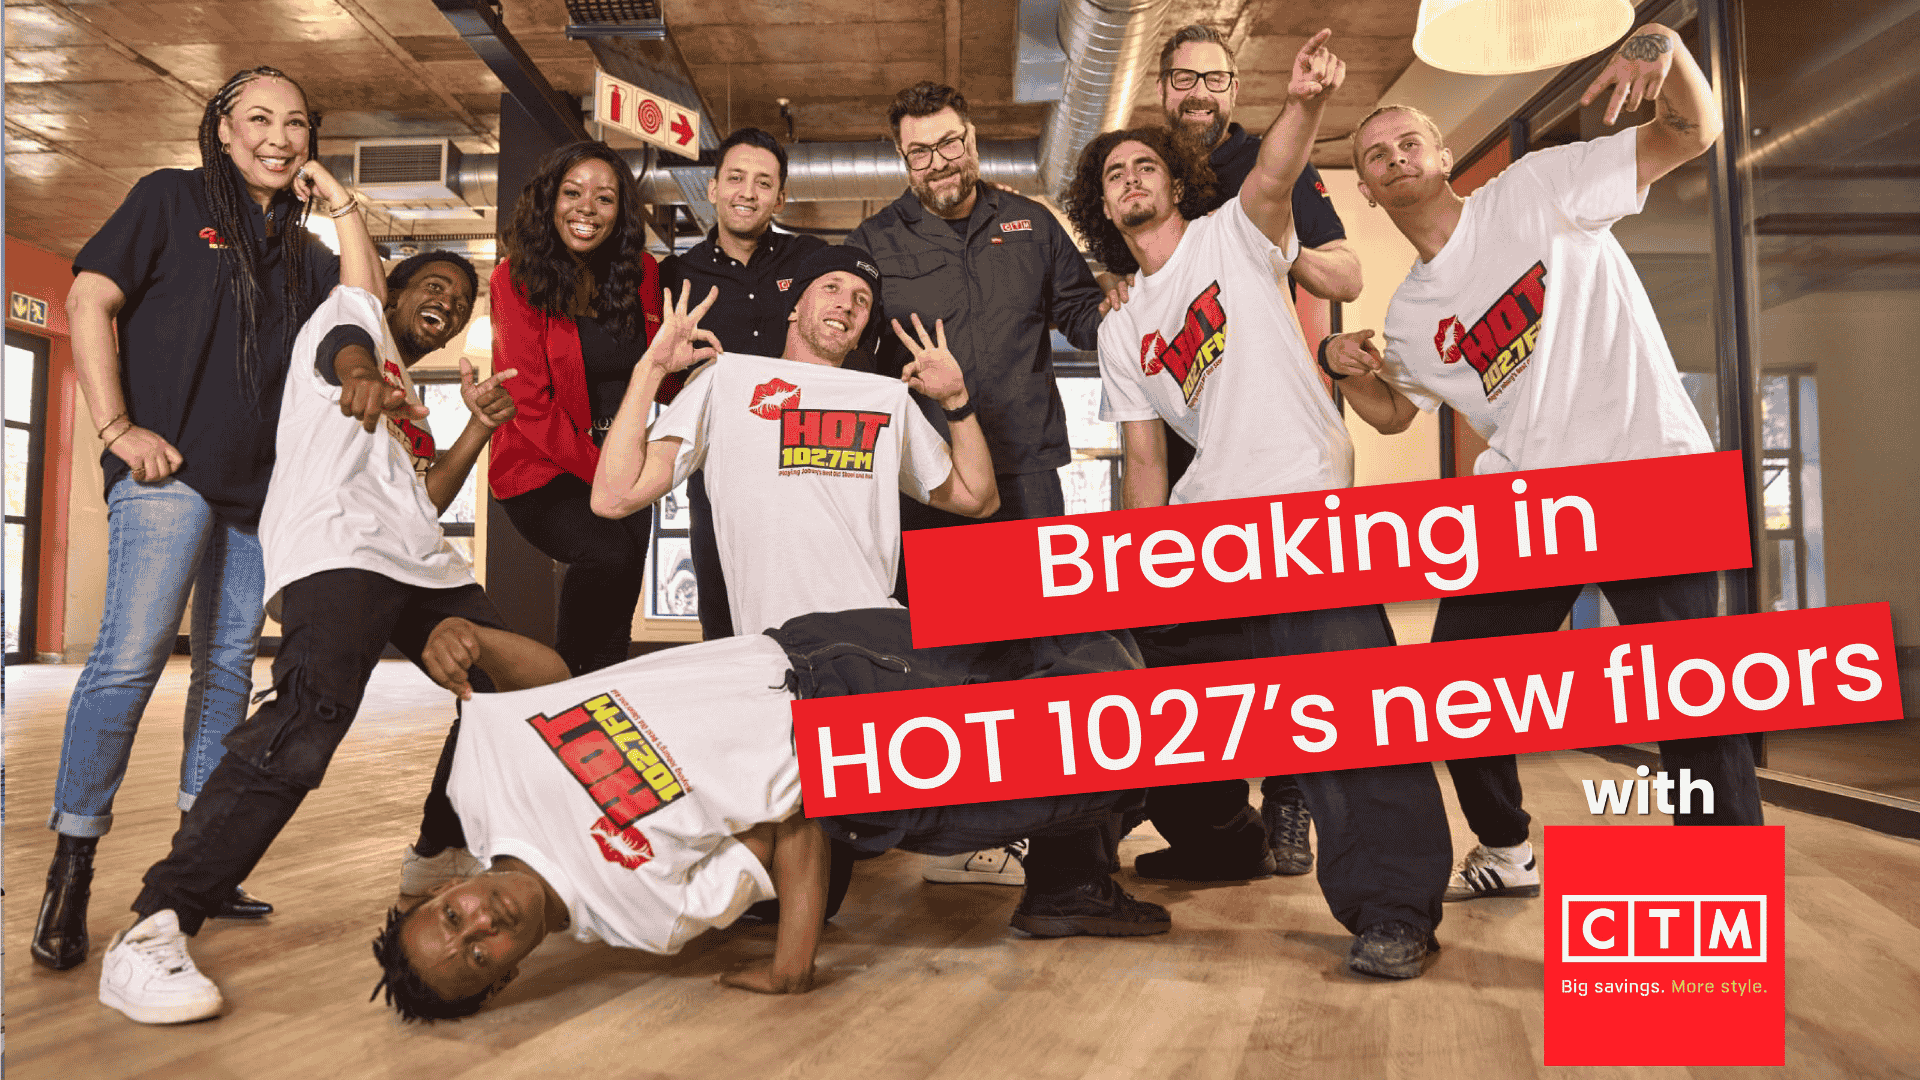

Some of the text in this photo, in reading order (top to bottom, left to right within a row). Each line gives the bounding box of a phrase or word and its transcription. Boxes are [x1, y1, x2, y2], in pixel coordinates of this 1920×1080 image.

[1001, 220, 1031, 232] CTM
[1459, 261, 1546, 375] HOT
[1482, 320, 1541, 393] 102.7F
[782, 409, 890, 451] HOT
[782, 447, 873, 470] 102.7FM
[528, 706, 662, 828] HOT
[584, 695, 682, 802] 102.7FM
